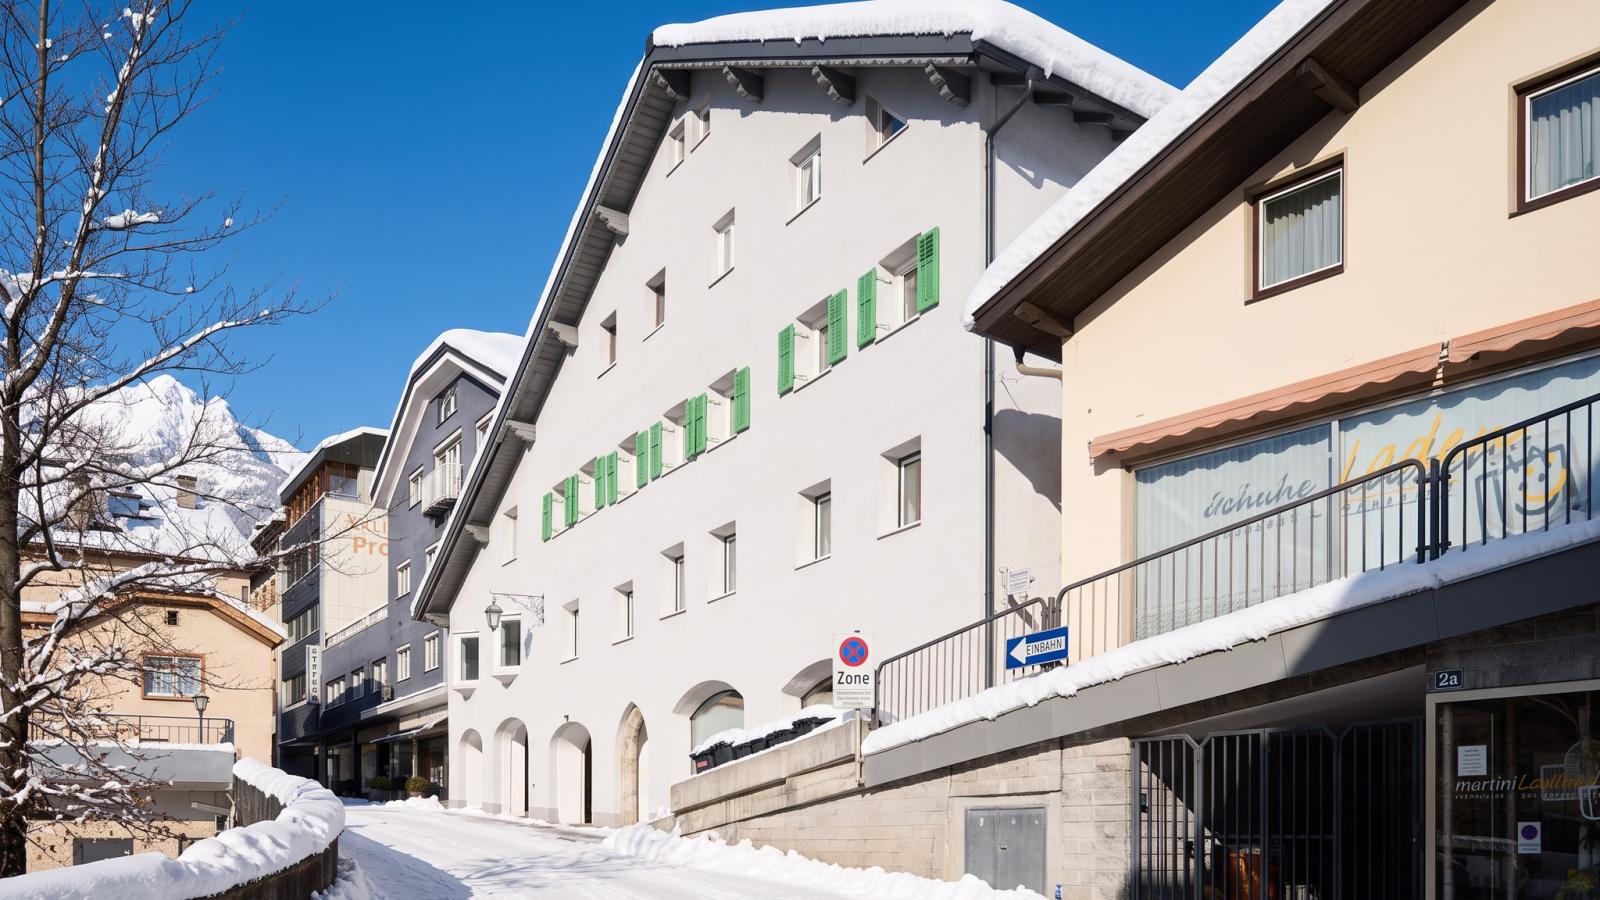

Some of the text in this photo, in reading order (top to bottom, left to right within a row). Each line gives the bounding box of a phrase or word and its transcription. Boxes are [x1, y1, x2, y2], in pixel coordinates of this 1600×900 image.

[1026, 638, 1063, 656] EINBAHN
[837, 671, 870, 685] Zone
[1439, 672, 1458, 687] 2a
